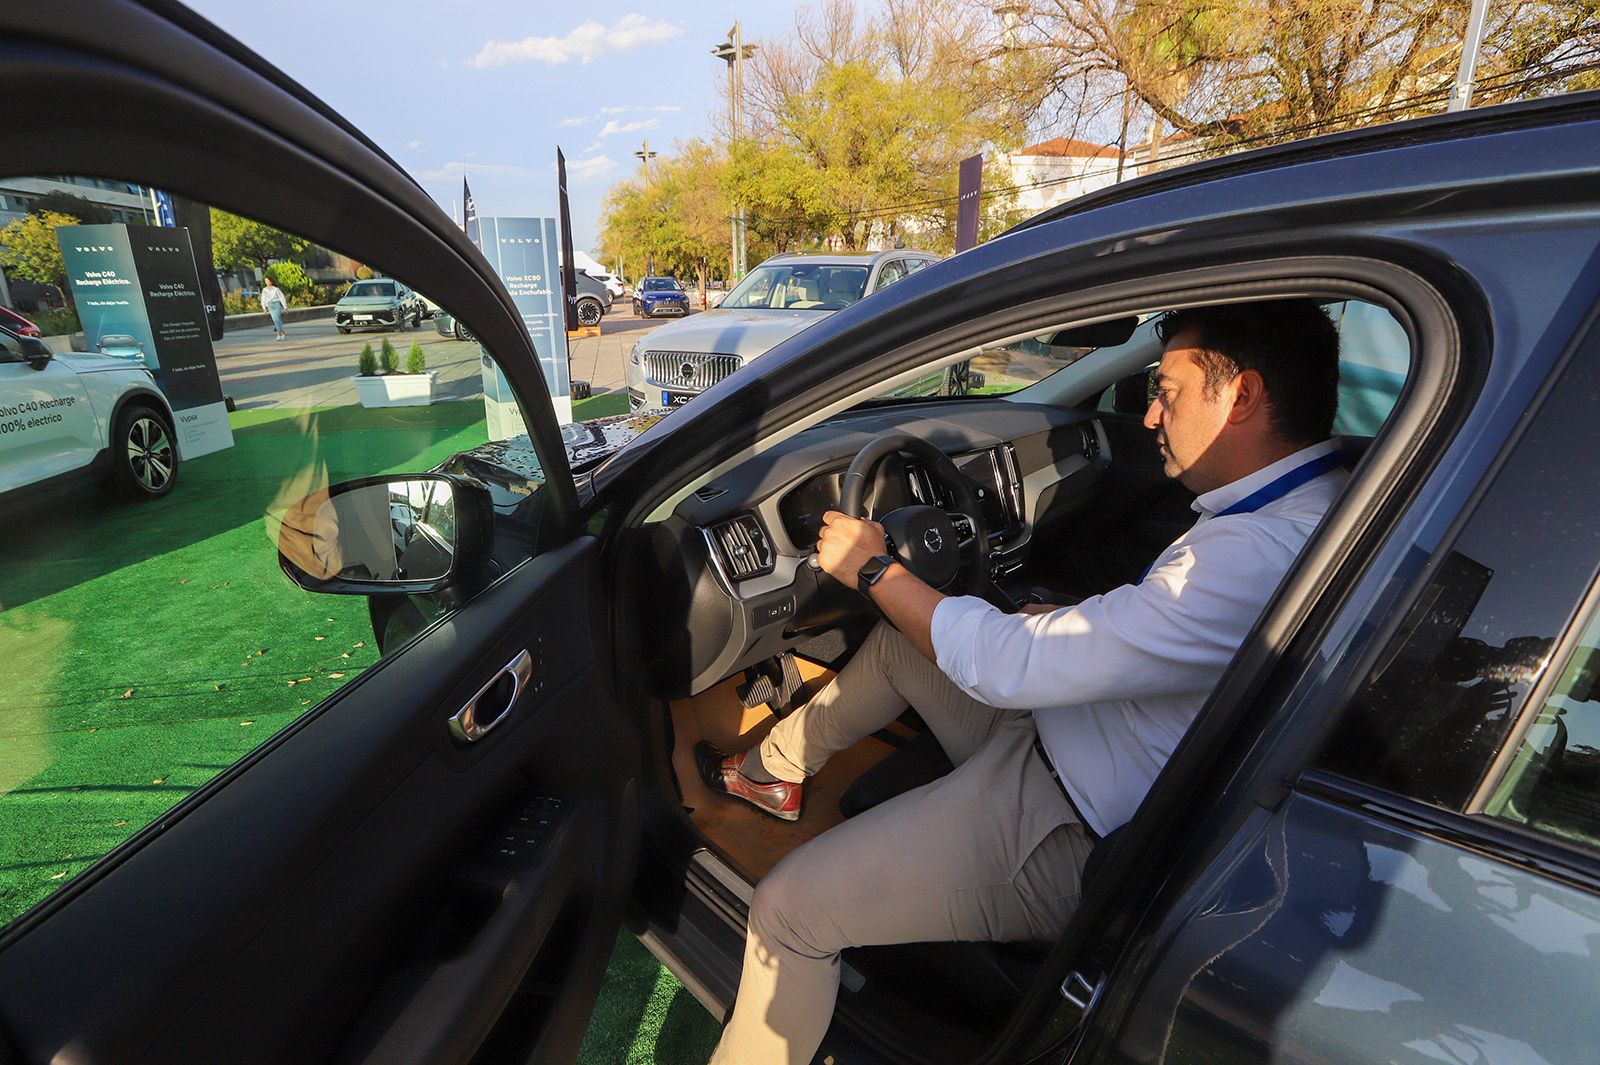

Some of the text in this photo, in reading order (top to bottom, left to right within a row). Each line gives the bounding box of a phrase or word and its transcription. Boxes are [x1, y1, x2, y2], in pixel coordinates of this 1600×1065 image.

[149, 290, 173, 298] Recharge
[0, 396, 75, 418] olvo C40 Recharge
[0, 414, 63, 434] 00% electrico
